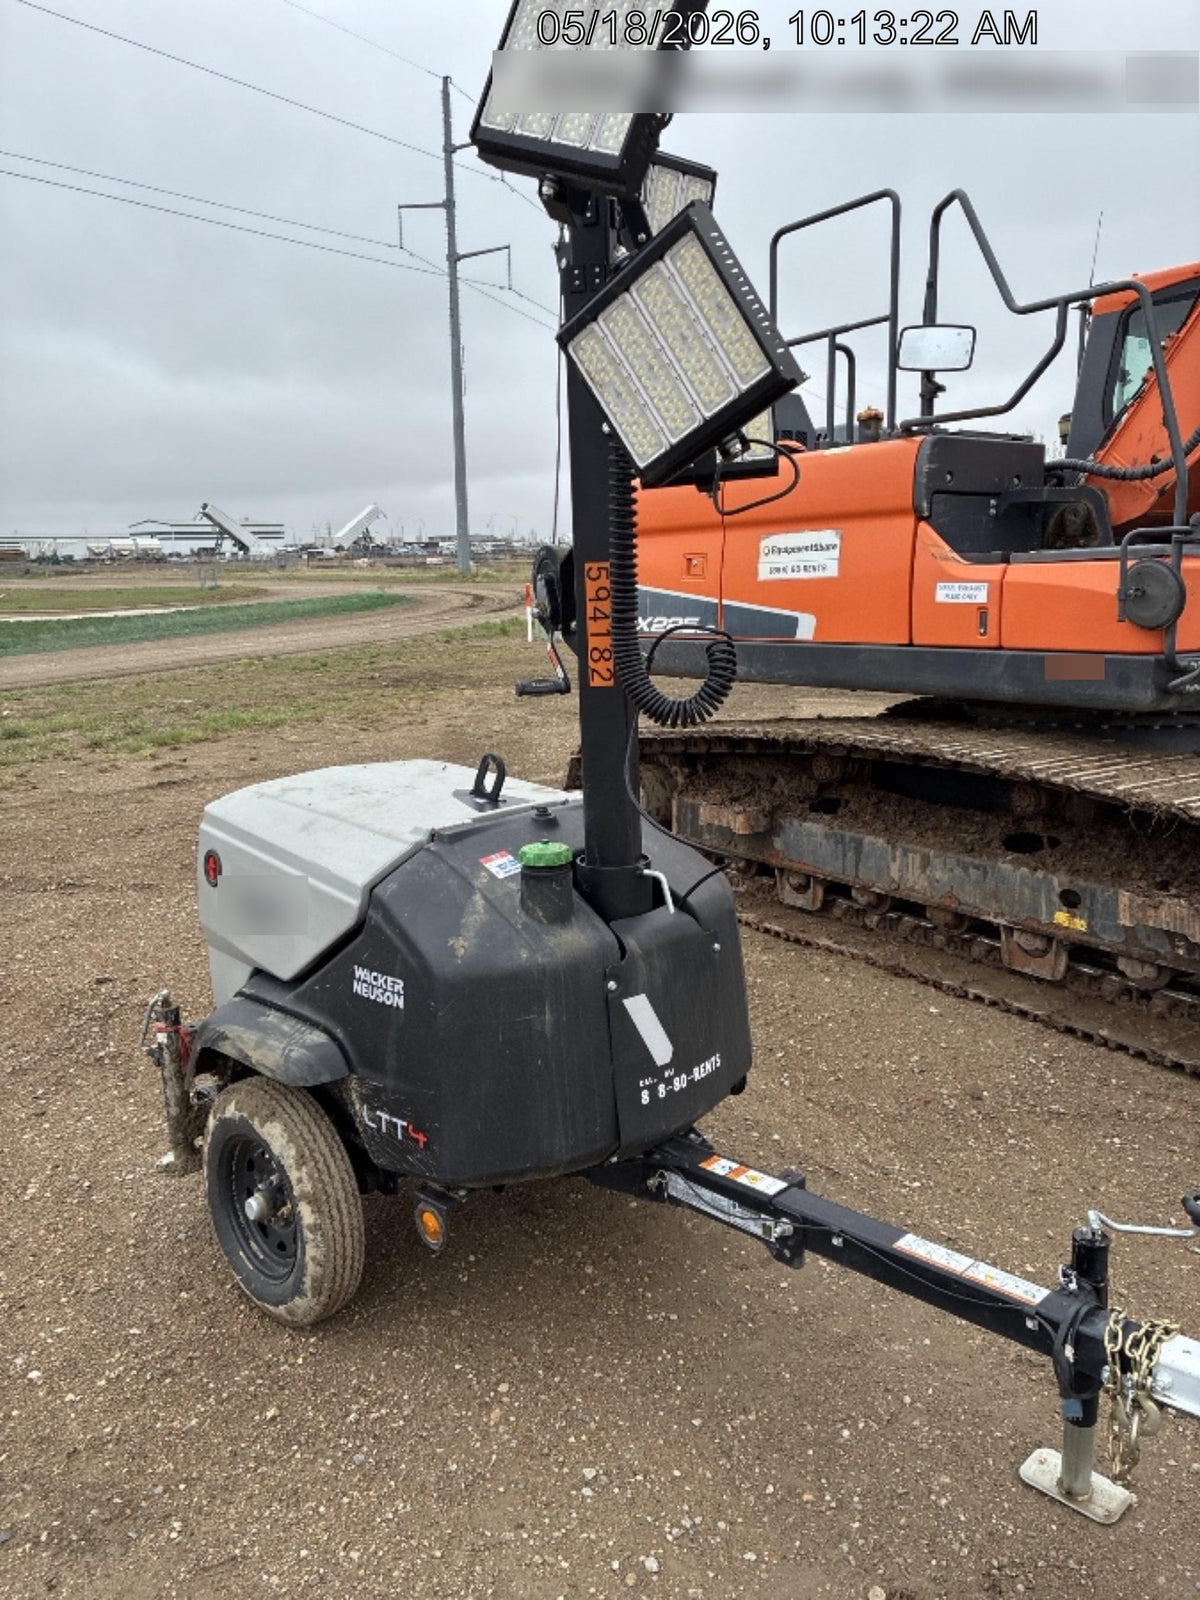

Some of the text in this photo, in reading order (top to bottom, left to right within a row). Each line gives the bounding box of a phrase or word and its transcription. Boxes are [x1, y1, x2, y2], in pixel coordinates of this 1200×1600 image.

[586, 565, 614, 682] 594182
[352, 978, 405, 1010] NEUSON
[353, 964, 405, 995] WACKER
[362, 1103, 428, 1150] LTT4
